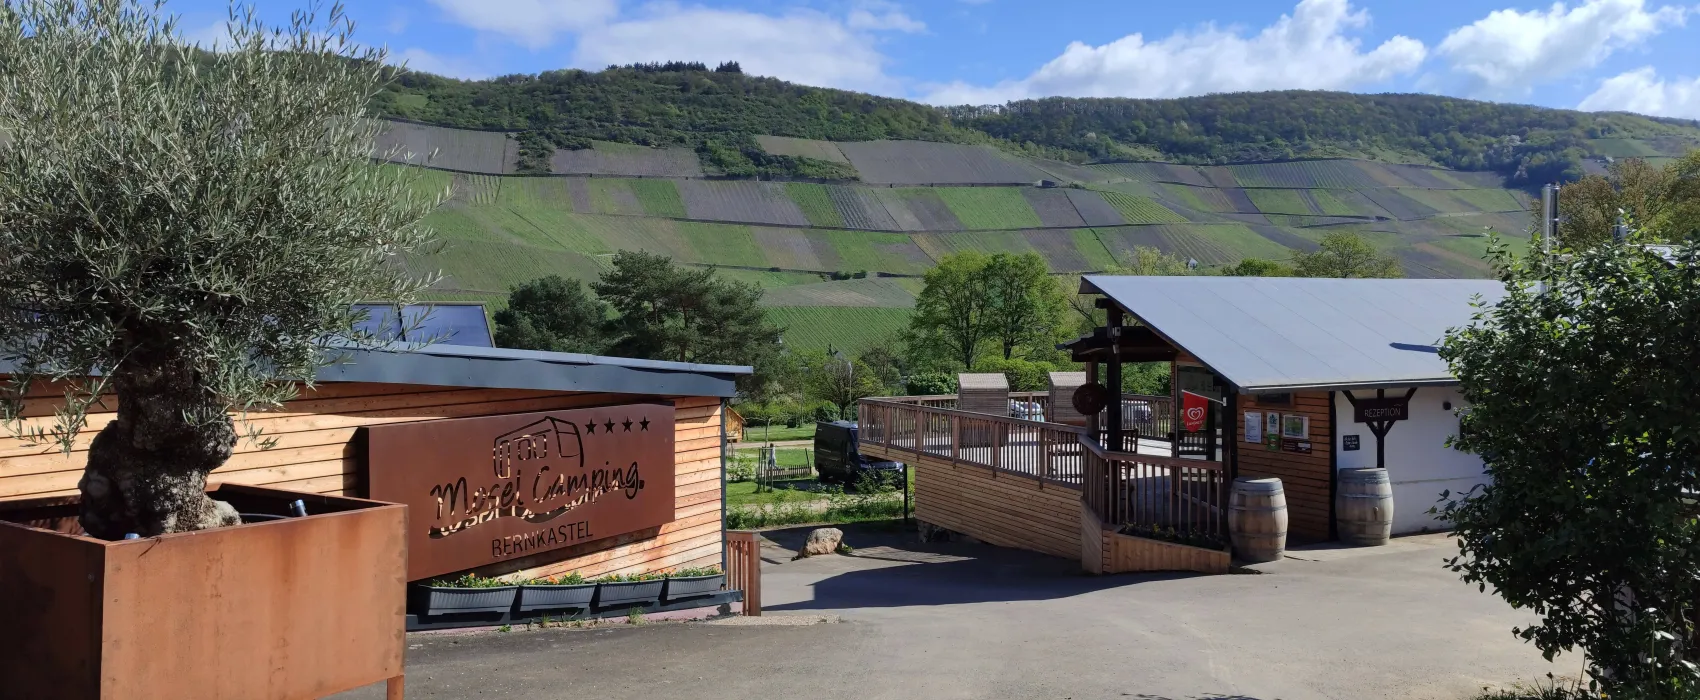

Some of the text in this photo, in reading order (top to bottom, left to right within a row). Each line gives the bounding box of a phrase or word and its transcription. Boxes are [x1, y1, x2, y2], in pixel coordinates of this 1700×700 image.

[1364, 407, 1401, 418] REZEPTION
[430, 469, 524, 520] Mosel
[491, 520, 594, 558] BERNKASTEL
